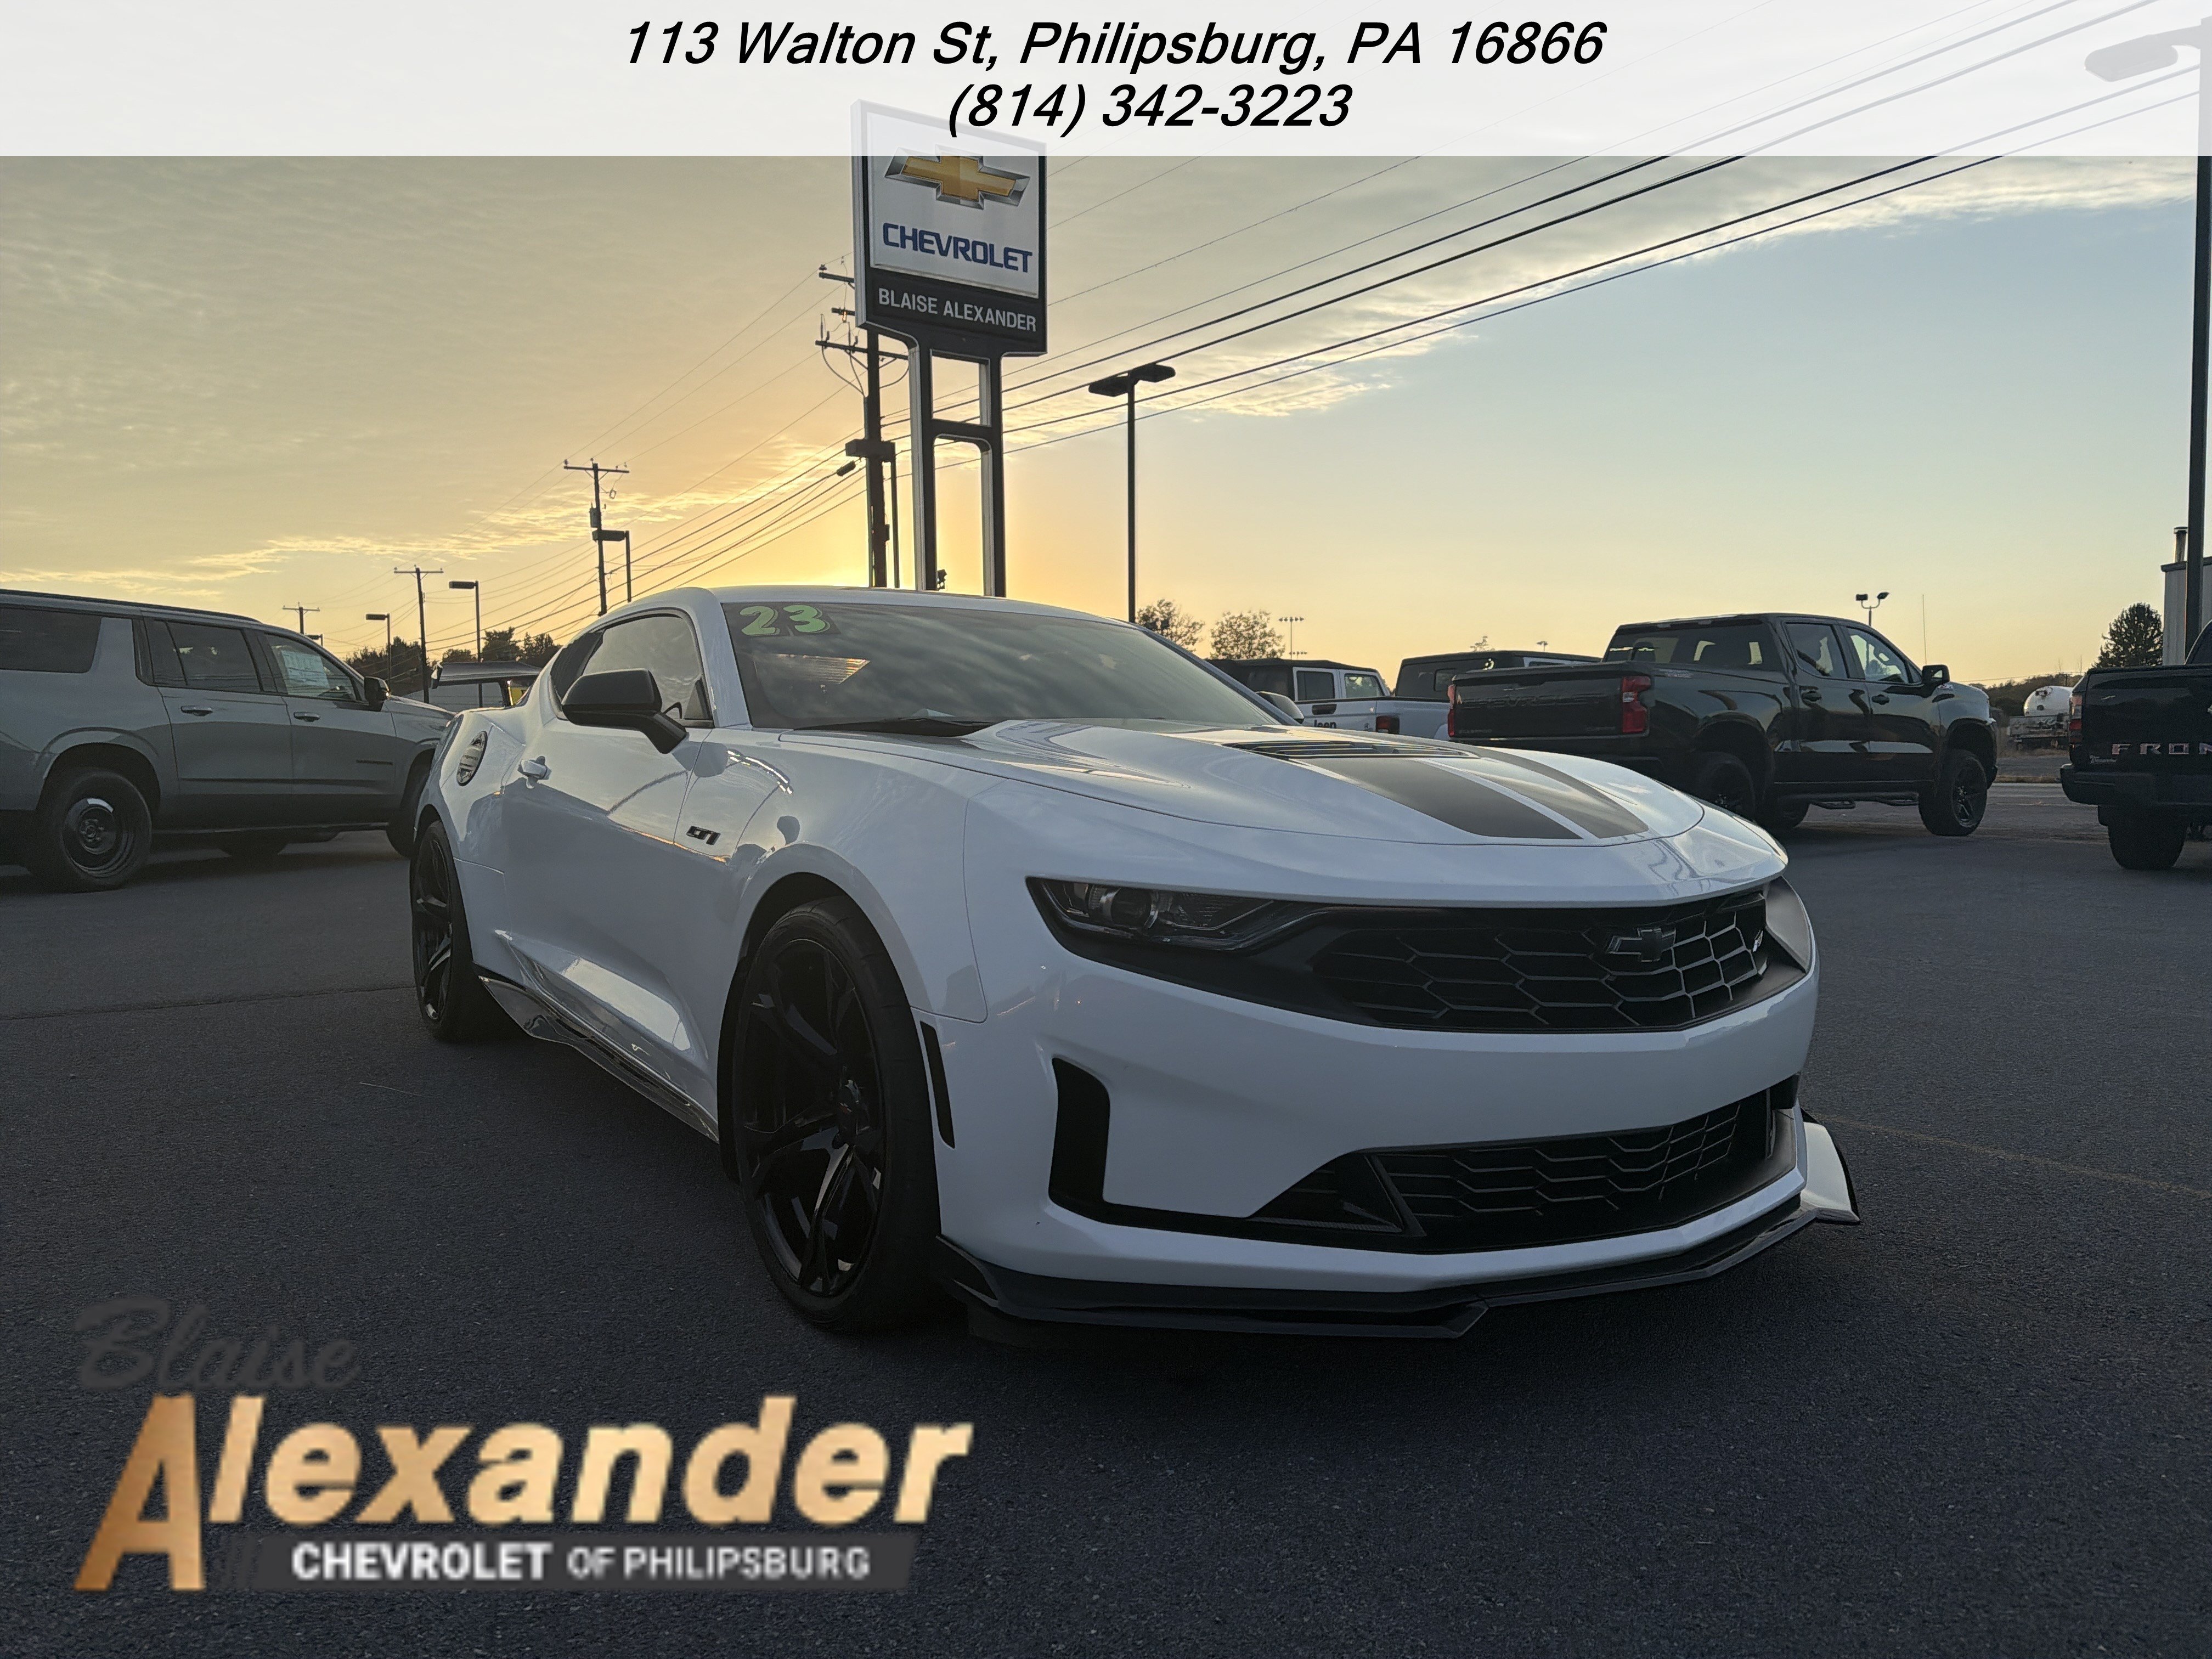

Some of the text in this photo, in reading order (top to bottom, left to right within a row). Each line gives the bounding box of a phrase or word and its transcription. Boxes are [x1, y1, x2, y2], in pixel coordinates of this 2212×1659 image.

[883, 222, 1032, 273] CHEVROLET
[878, 287, 1036, 332] BLAISE ALEXANDER
[740, 605, 831, 636] 23
